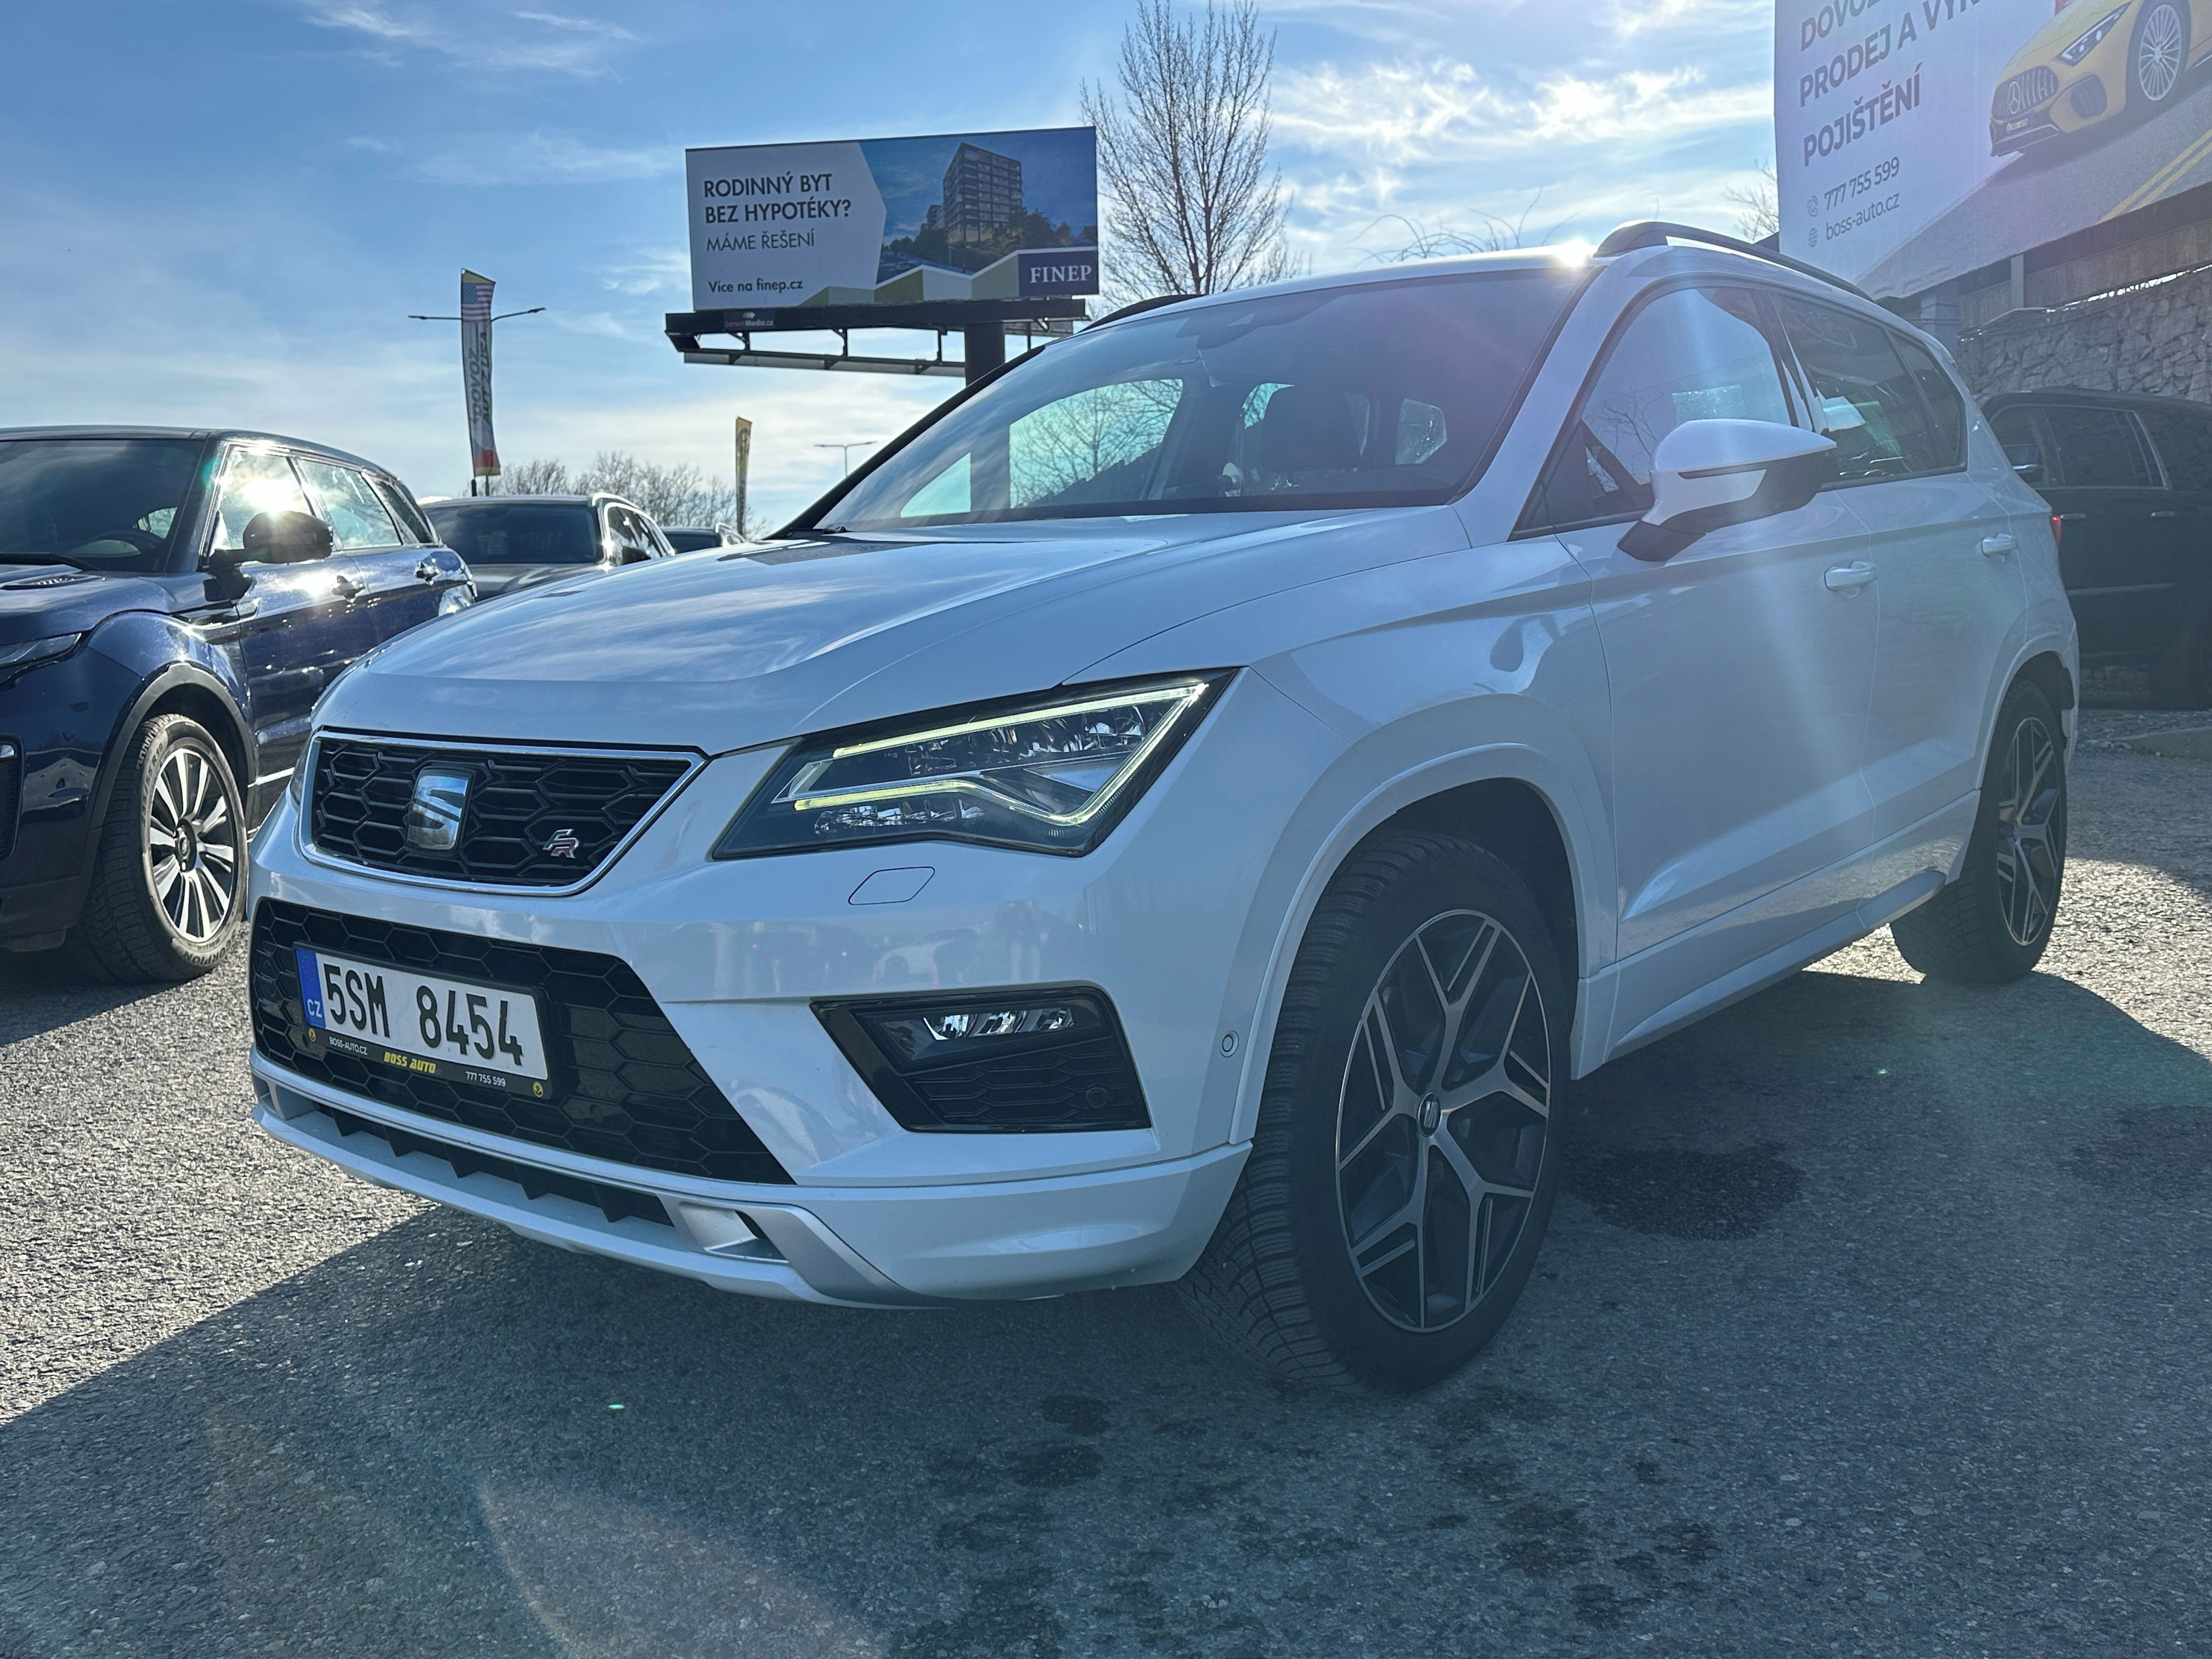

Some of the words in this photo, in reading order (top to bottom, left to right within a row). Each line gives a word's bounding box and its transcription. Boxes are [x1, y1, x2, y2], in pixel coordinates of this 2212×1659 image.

[1801, 0, 1880, 51] DOVO
[1800, 24, 1891, 108] PRODEJ
[1897, 12, 1917, 50] A
[1804, 61, 1922, 167] POJIŠTĚNÍ
[704, 171, 794, 198] RODINNÝ
[800, 173, 832, 193] BYT
[1824, 183, 1847, 211] 777
[1849, 170, 1871, 198] 755
[1874, 156, 1899, 185] 599
[706, 205, 738, 224] BEZ
[744, 195, 851, 222] HYPOTÉKY?
[1826, 193, 1900, 240] boss-auto.cz
[707, 233, 755, 251] MÁME
[761, 228, 815, 249] ŘEŠENÍ
[708, 280, 733, 294] Více
[737, 282, 752, 292] na
[757, 278, 803, 294] finep.cz
[1030, 265, 1092, 283] FINEP
[307, 998, 323, 1019] CZ
[323, 963, 390, 1039] 5SM
[416, 985, 523, 1066] 8454
[329, 1036, 368, 1056] BOSS-AUTO.CZ
[384, 1051, 408, 1069] BOSS
[409, 1058, 437, 1074] AUTO
[465, 1070, 477, 1081] 777
[477, 1072, 492, 1084] 755
[493, 1076, 506, 1087] 599
